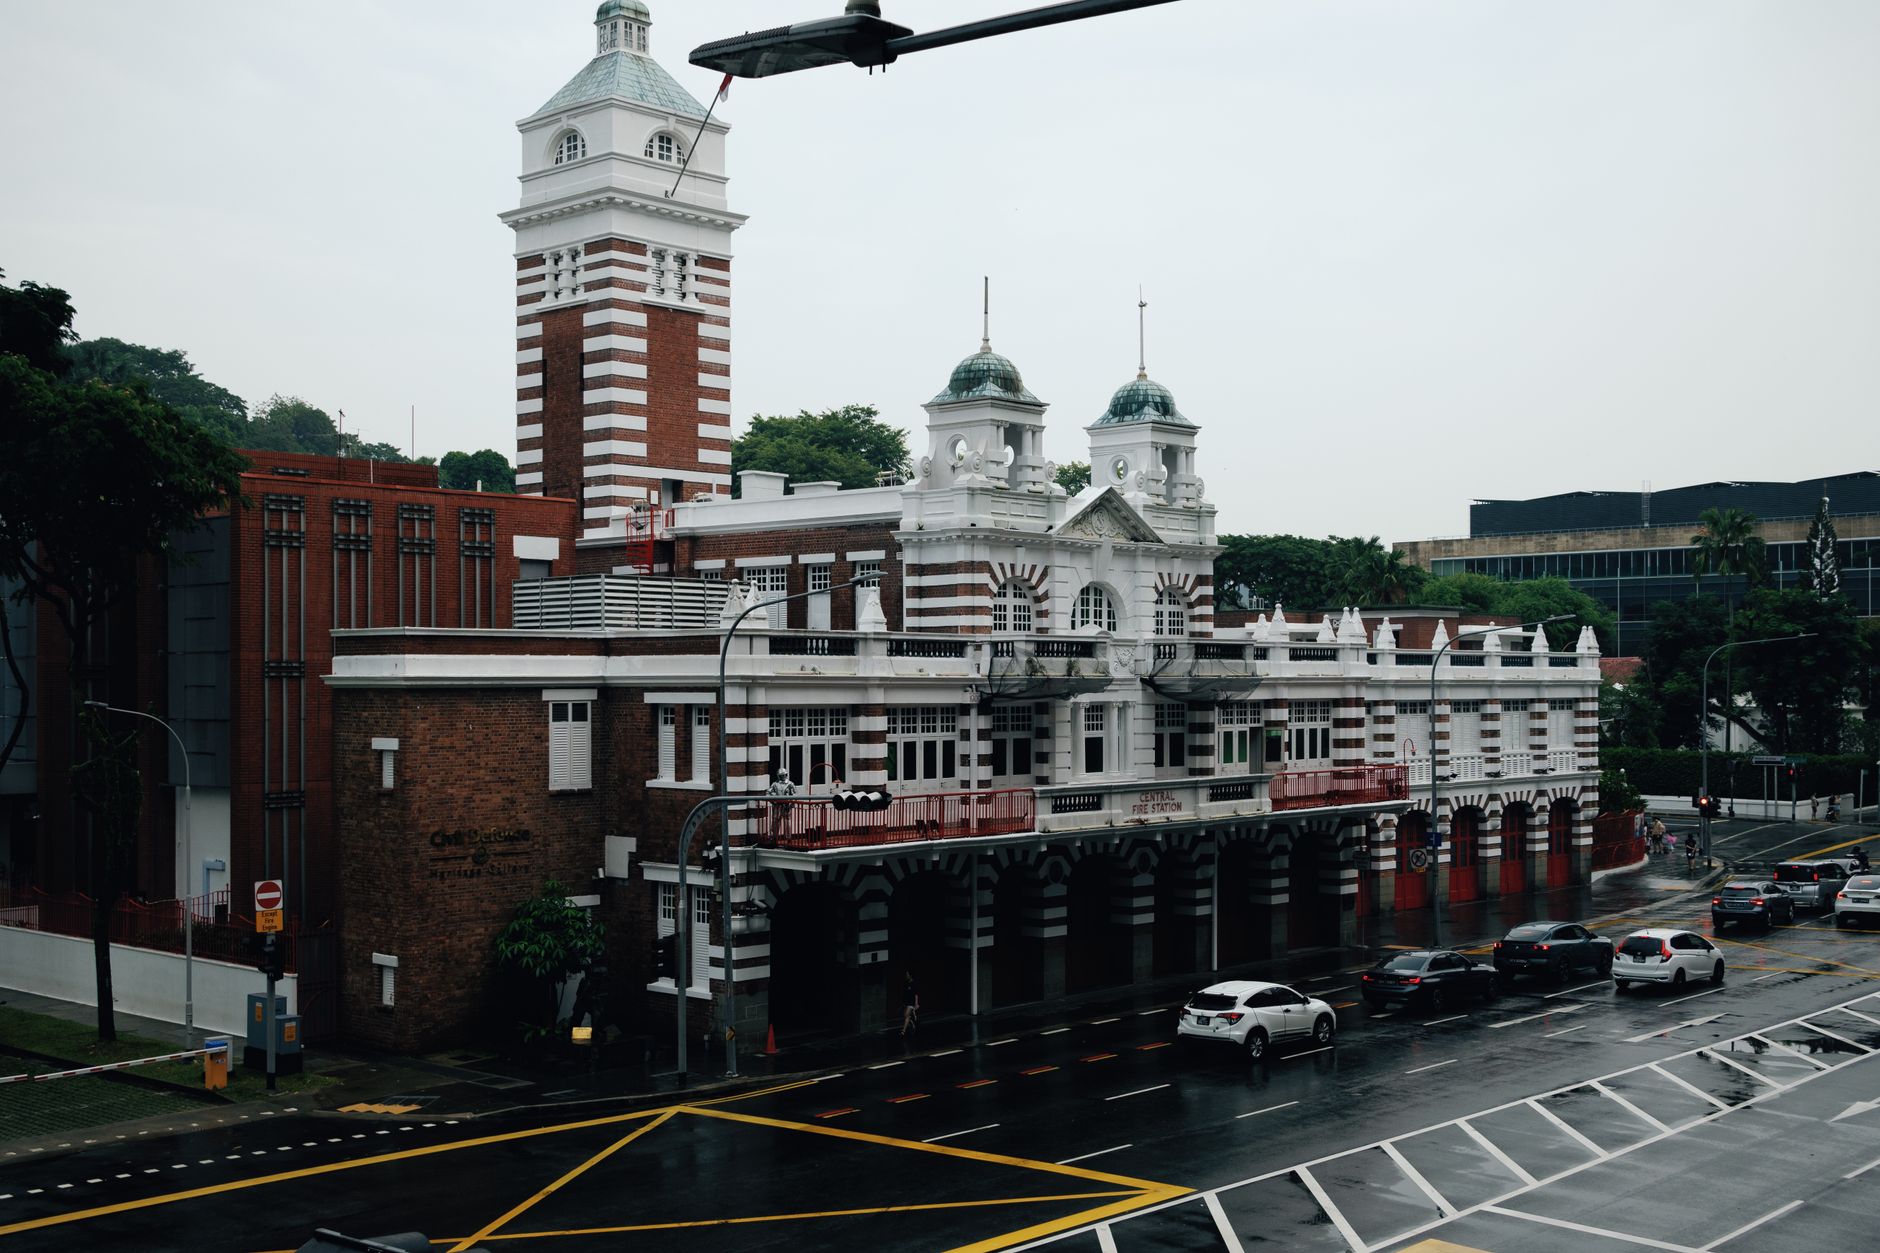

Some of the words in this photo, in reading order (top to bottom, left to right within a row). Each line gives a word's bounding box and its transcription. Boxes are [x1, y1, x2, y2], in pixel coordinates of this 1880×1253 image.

[1140, 791, 1175, 802] CENTRAL
[1132, 804, 1148, 814] FIRE
[1151, 802, 1182, 813] STATION
